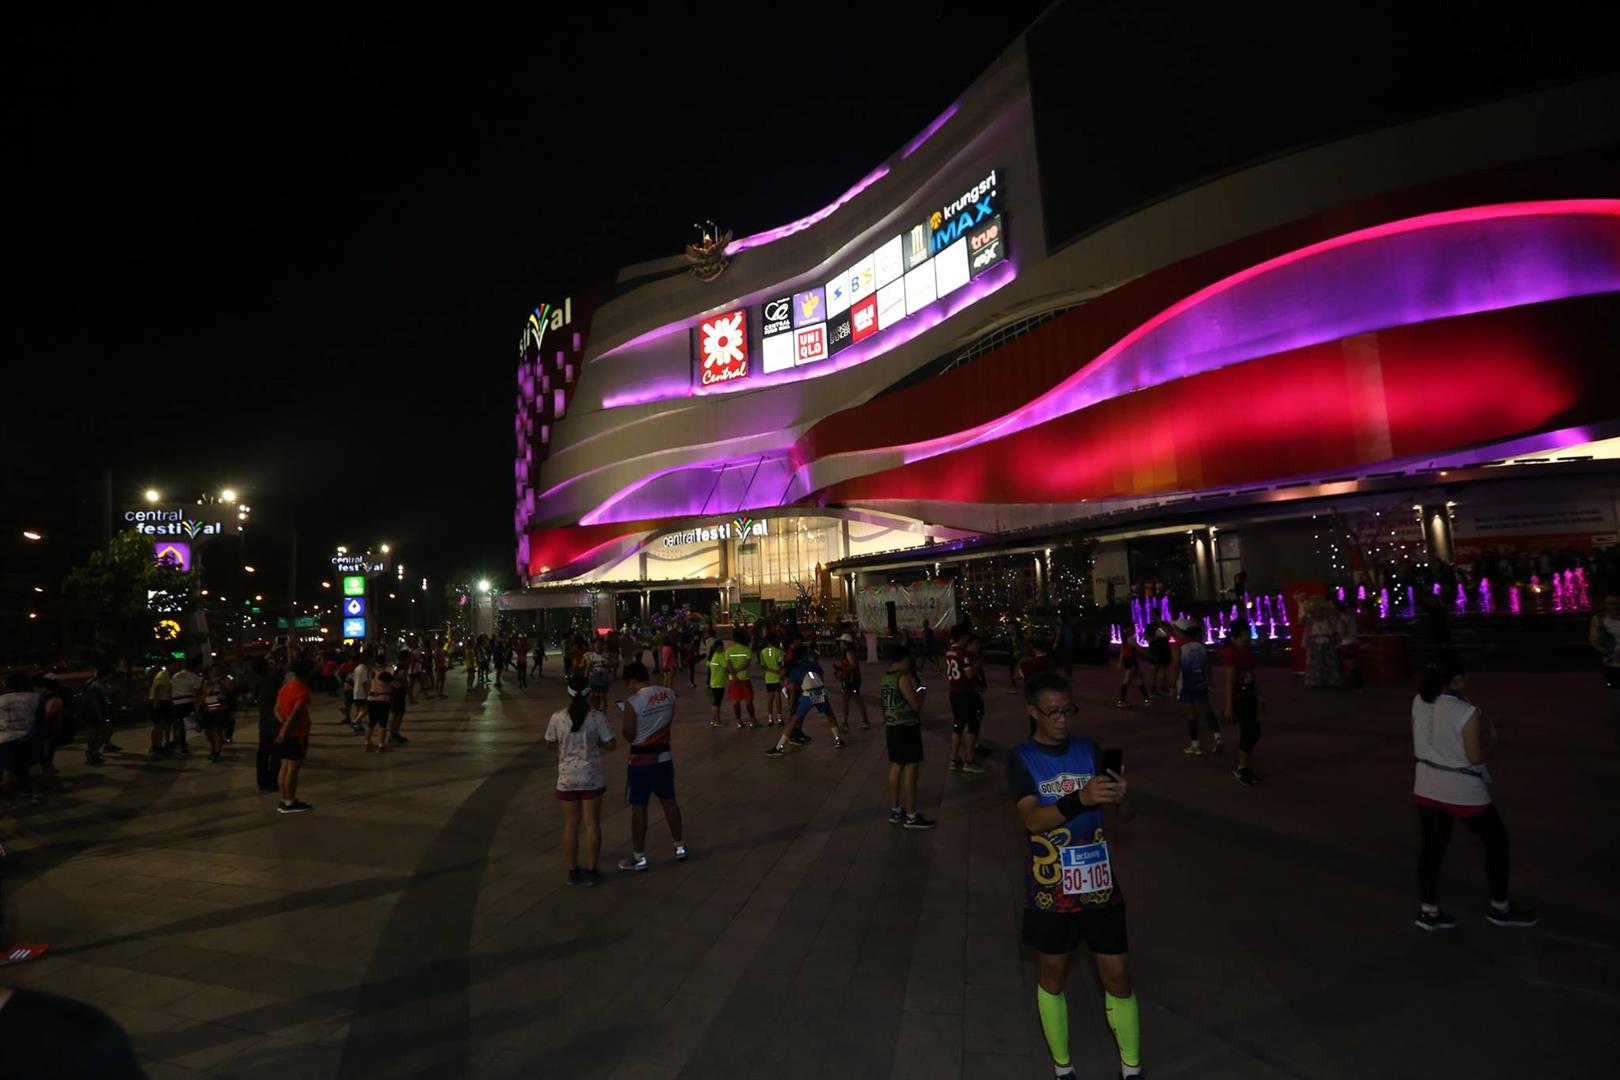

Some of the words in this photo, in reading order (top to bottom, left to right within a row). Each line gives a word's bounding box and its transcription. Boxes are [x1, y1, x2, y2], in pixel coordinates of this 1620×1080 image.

[943, 169, 996, 220] krungsri
[931, 194, 993, 253] IMAX
[971, 225, 998, 250] true
[800, 331, 819, 345] UNI
[800, 343, 821, 358] QLO
[702, 361, 746, 385] Central
[125, 509, 182, 521] central
[331, 556, 363, 564] central
[1064, 863, 1110, 891] 50-105
